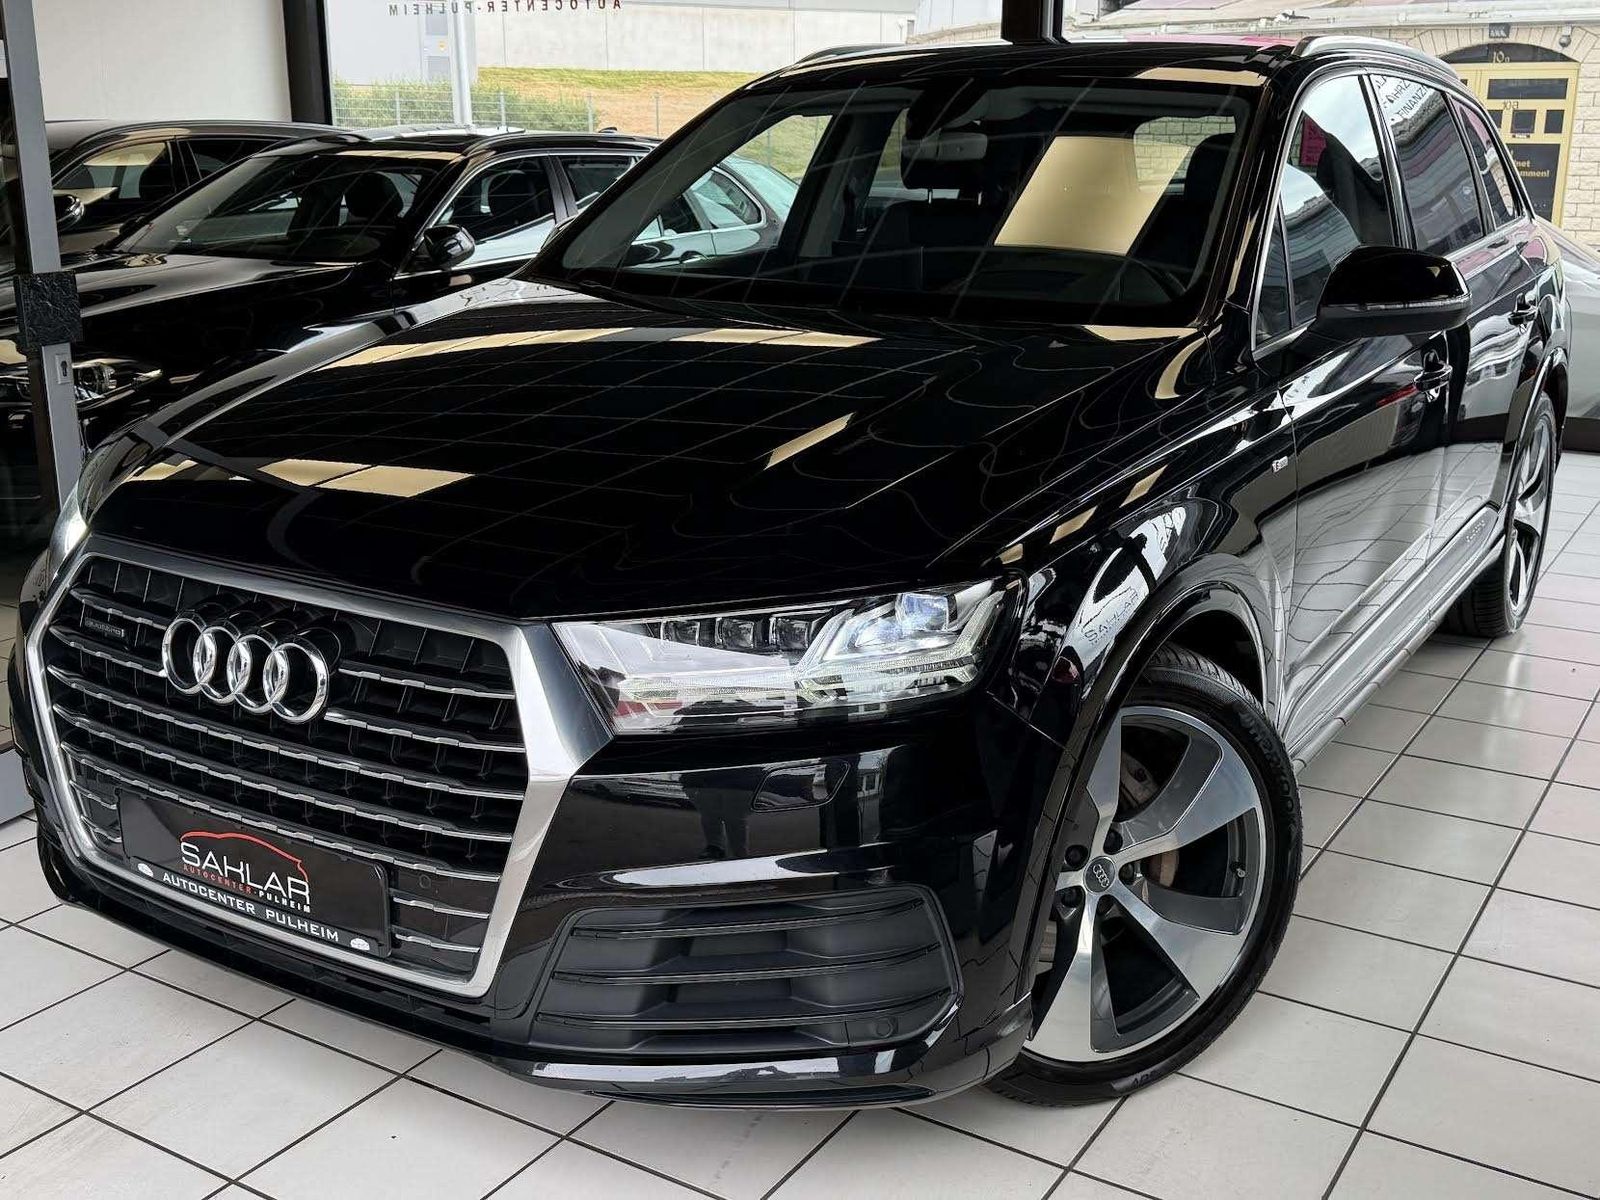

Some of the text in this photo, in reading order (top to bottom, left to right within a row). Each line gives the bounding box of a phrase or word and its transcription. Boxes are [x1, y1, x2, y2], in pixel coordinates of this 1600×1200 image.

[180, 841, 310, 904] SAHLAR
[162, 872, 339, 942] AUTOCENTER PULHEIM
